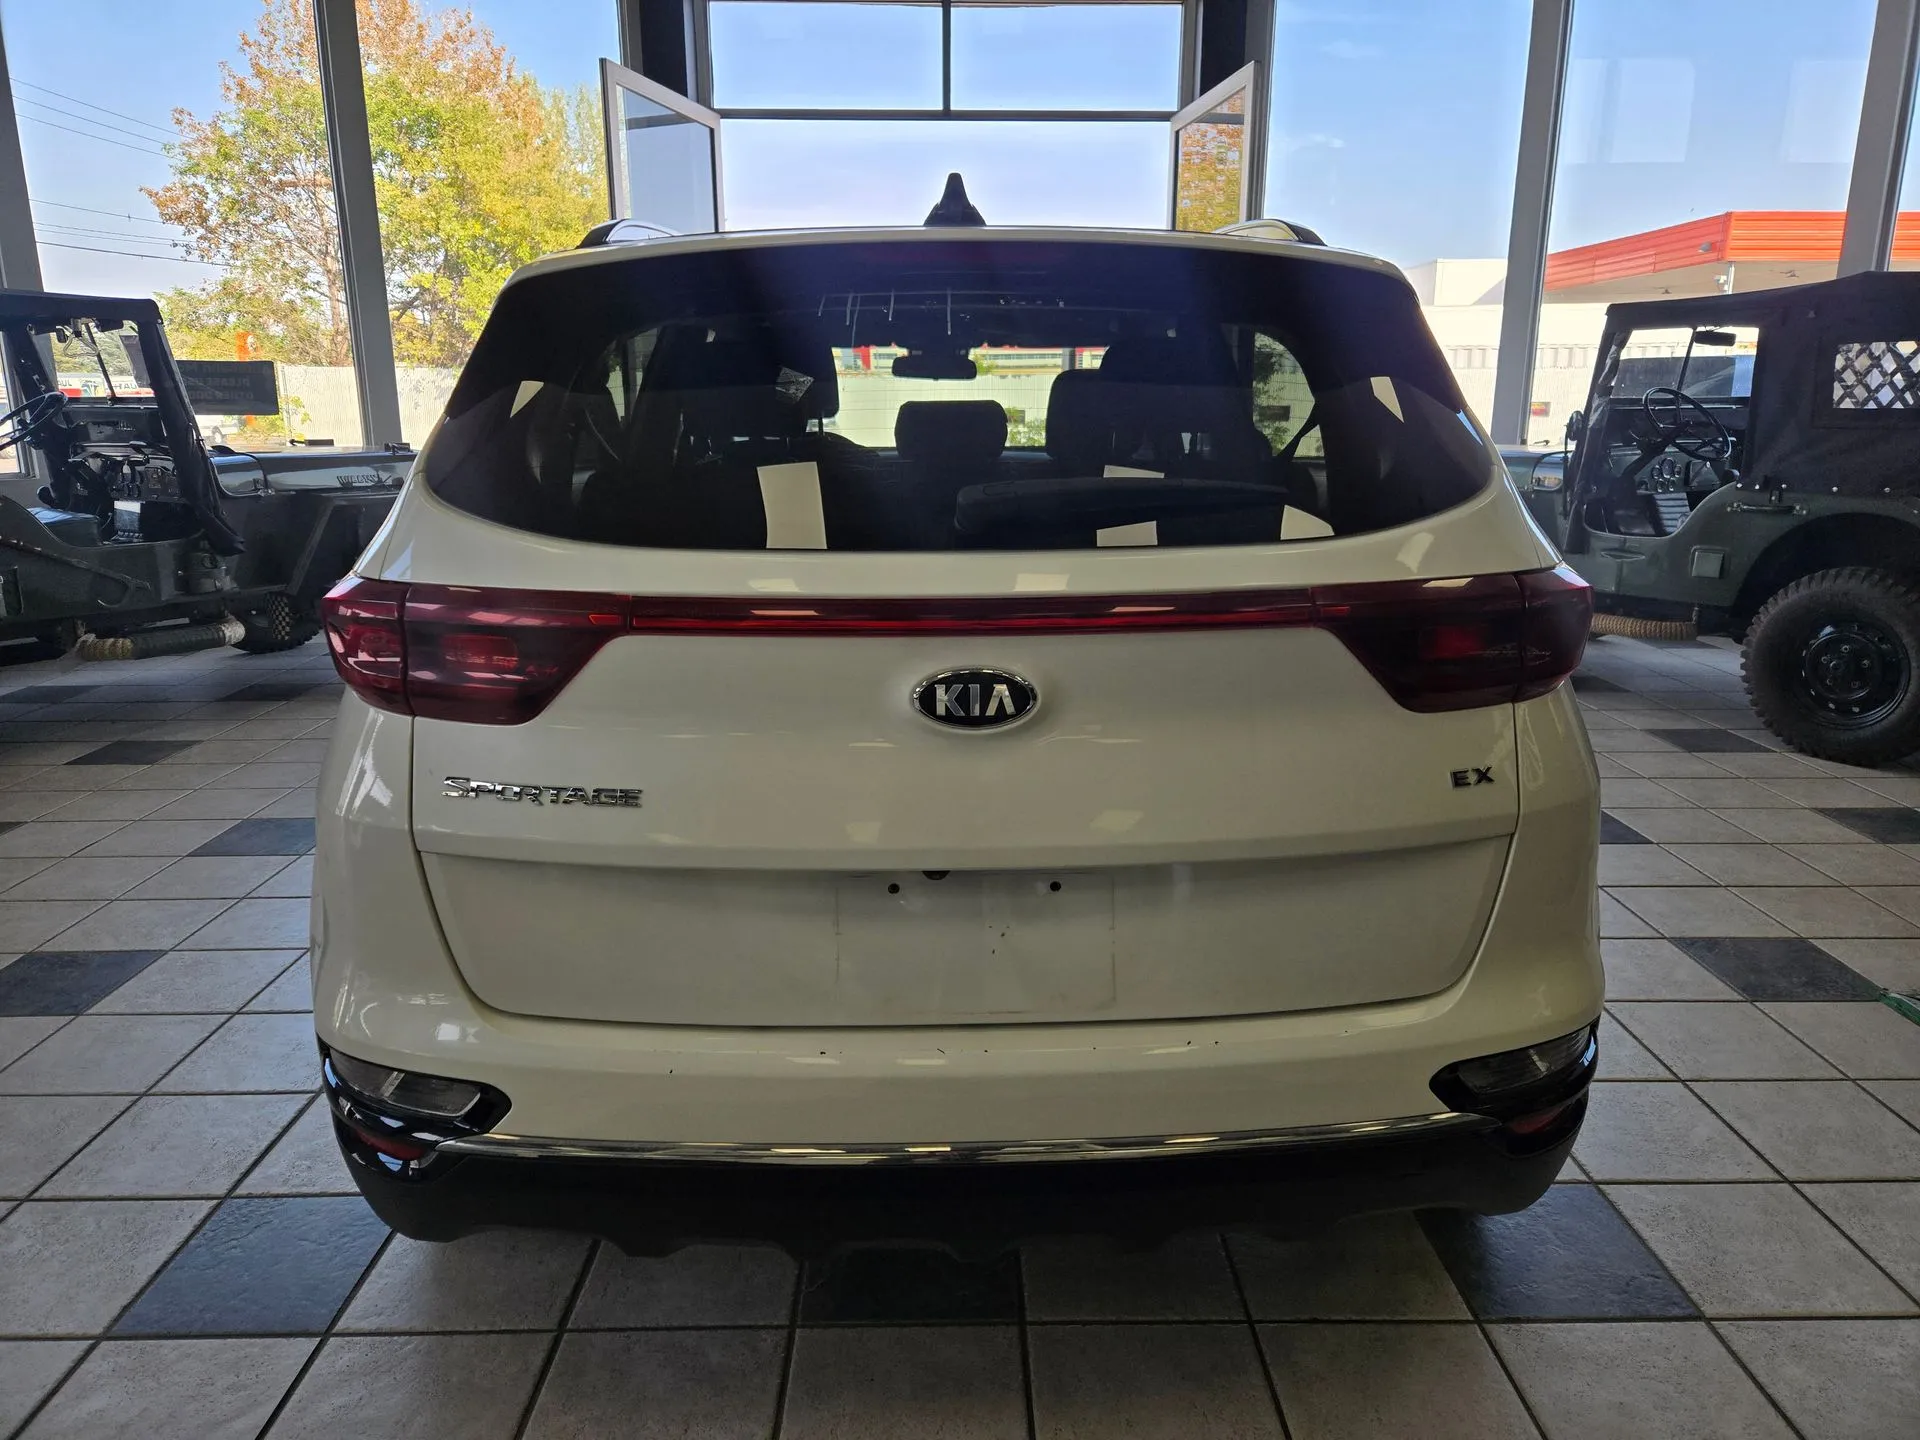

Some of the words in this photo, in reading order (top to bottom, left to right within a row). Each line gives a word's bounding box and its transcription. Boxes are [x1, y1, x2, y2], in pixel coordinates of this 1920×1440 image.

[934, 683, 1017, 716] KIA
[441, 776, 643, 808] SPORTAGE
[1450, 766, 1495, 788] EX
